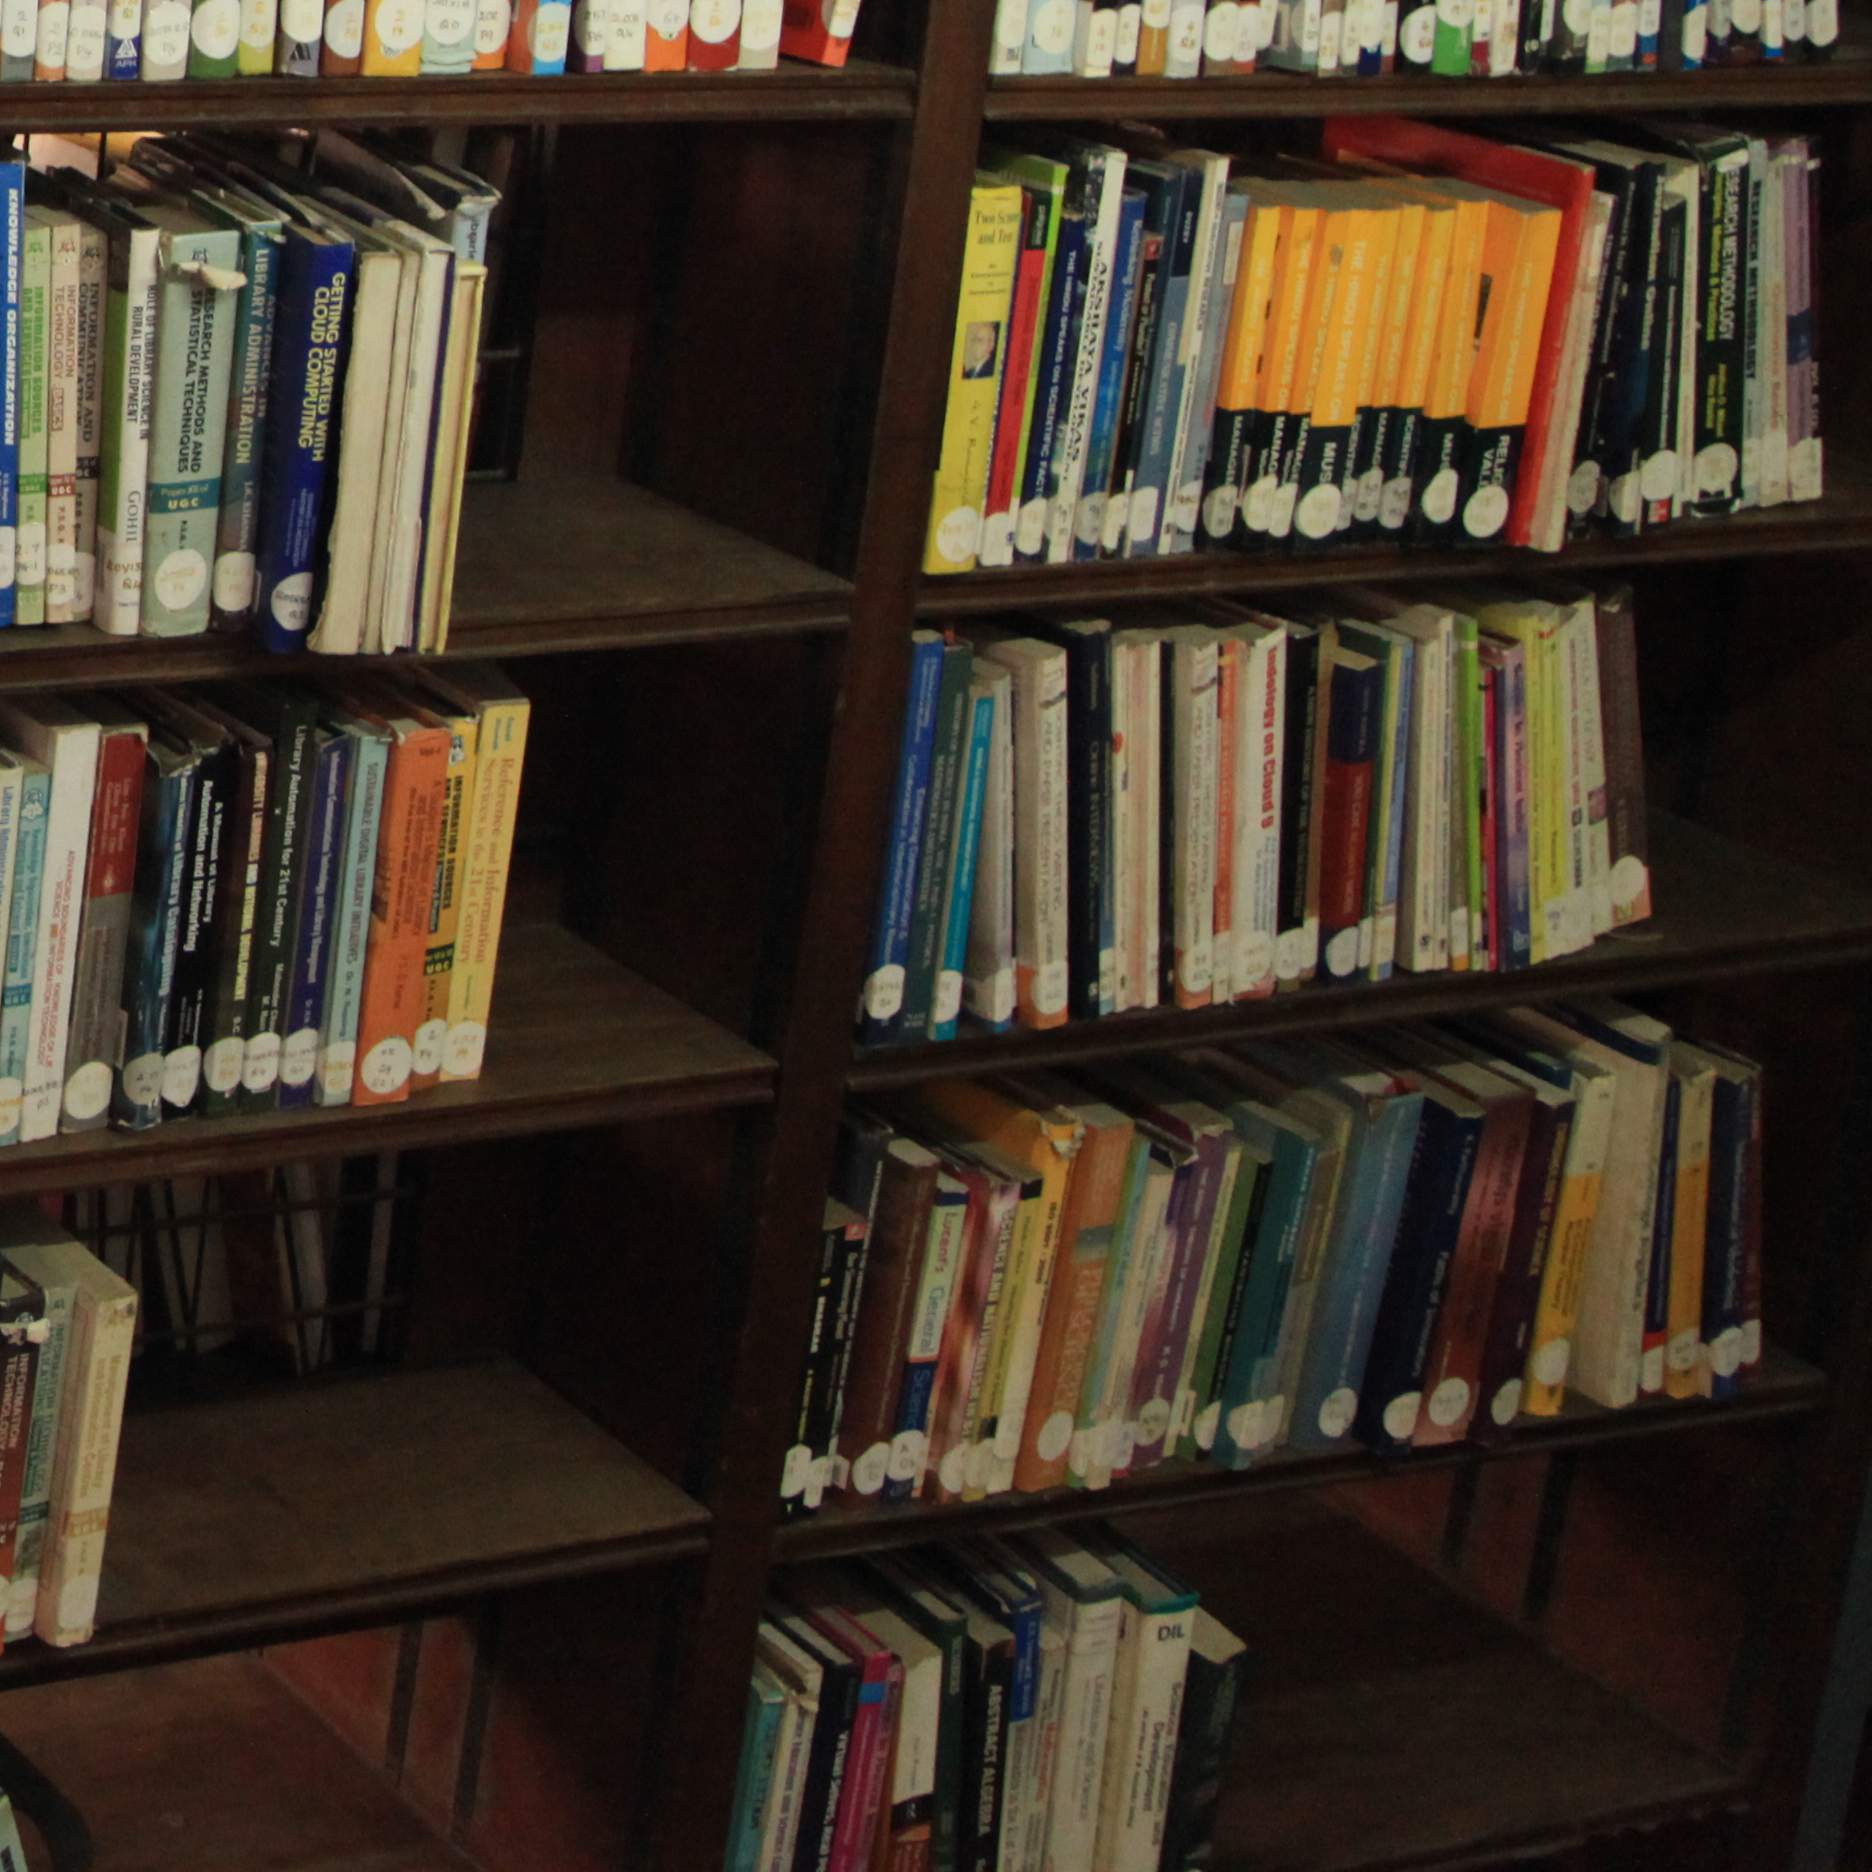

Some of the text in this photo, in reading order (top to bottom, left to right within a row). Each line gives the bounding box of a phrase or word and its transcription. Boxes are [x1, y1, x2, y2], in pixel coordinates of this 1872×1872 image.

[3, 187, 19, 446] KNOWLEDGE ORGANIZATION
[236, 248, 270, 465] LIBRARY ADMINISTRATION
[297, 285, 328, 450] CLOUD COMPUTING
[311, 271, 346, 463] GETTING STARTED WITH
[168, 499, 199, 509] UGC
[1261, 646, 1281, 829] Indology on Cloud 9
